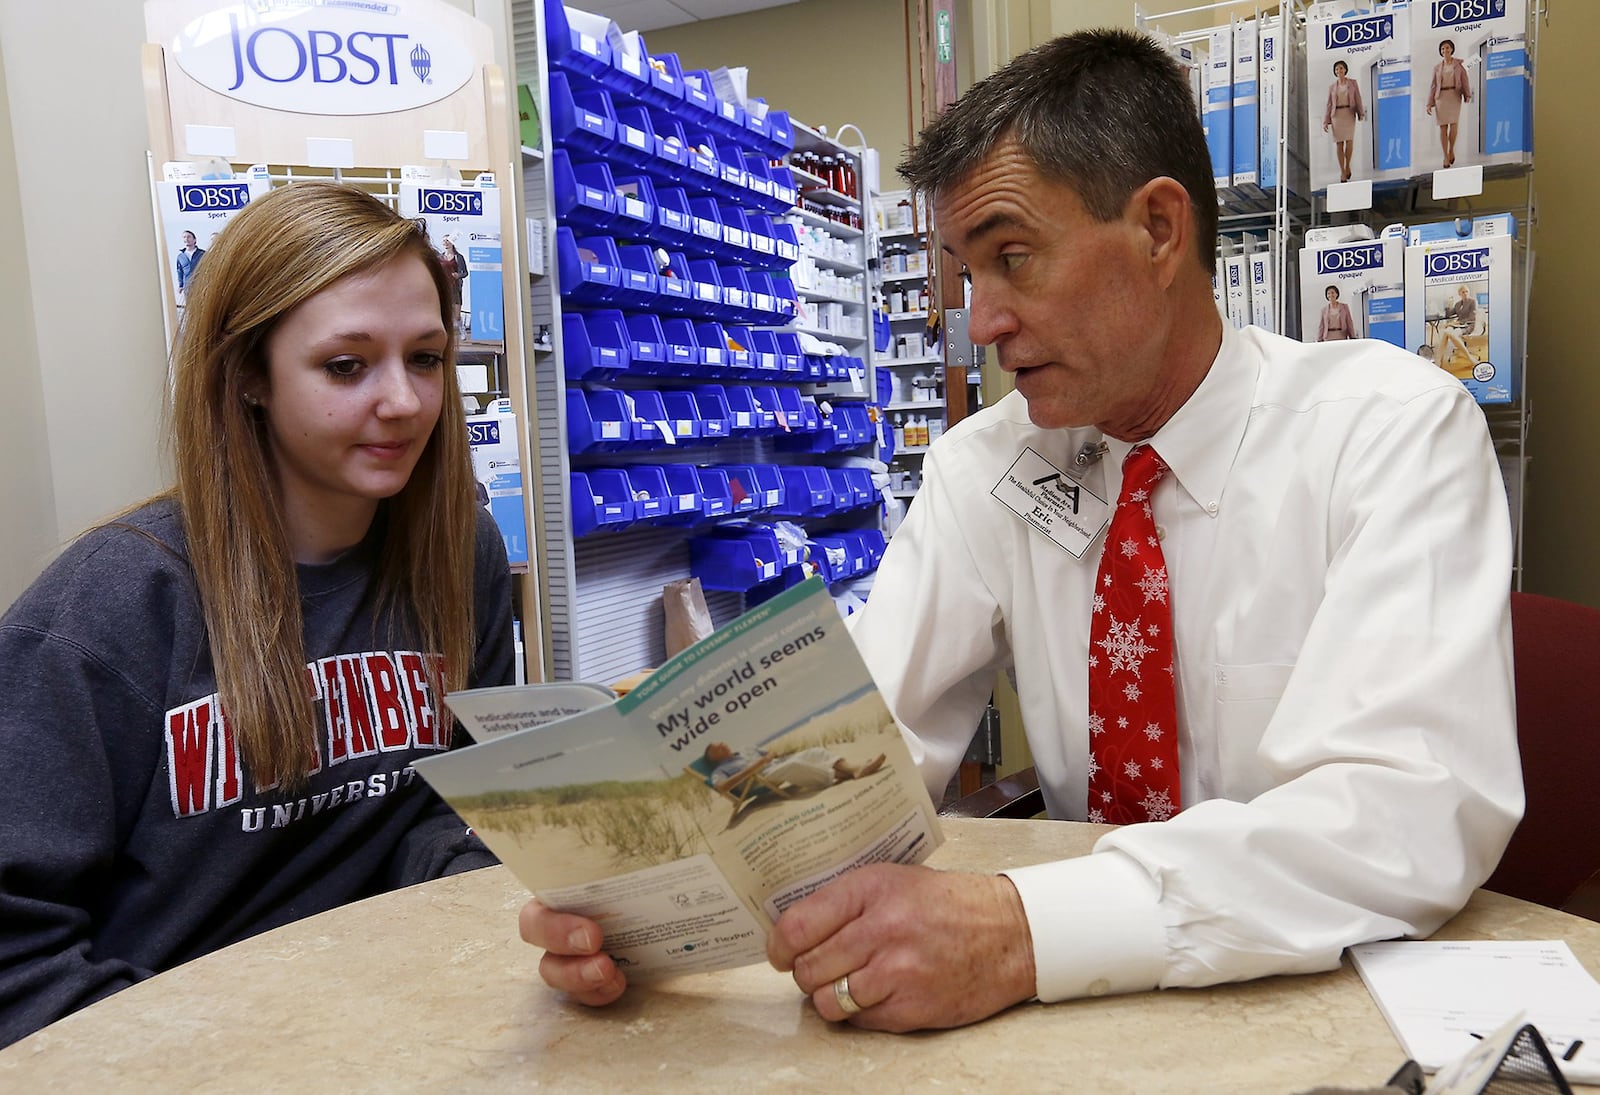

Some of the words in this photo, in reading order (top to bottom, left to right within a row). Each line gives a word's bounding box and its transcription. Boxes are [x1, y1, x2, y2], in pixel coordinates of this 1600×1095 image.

[1432, 0, 1491, 27] JOBST
[1327, 19, 1385, 48] JOBST
[1454, 23, 1482, 32] Opaque
[228, 13, 409, 90] JOBST
[1347, 45, 1372, 54] Opaque
[179, 185, 240, 211] JOBST
[419, 188, 475, 212] JOBST
[1318, 247, 1375, 274] JOBST
[1425, 251, 1481, 276] JOBST
[1338, 271, 1363, 280] Opaque
[1430, 275, 1455, 284] Medical
[467, 424, 492, 442] BST
[1008, 475, 1016, 484] The
[1040, 491, 1064, 511] Pharmacy
[1024, 512, 1051, 533] Pharmacist
[1031, 506, 1053, 525] Eric
[636, 679, 660, 700] YOUR
[658, 662, 683, 682] GUIDE
[683, 652, 696, 664] TO
[679, 684, 695, 700] my
[694, 655, 739, 687] diabetes
[748, 631, 779, 653] under
[655, 707, 690, 739] My
[694, 661, 756, 709] world
[760, 626, 826, 669] seems
[474, 709, 535, 723] Indications
[538, 707, 560, 716] and
[669, 713, 721, 752] wide
[725, 677, 779, 714] open
[165, 650, 452, 820] WIENBE
[241, 766, 417, 832] UNIVERSIT
[739, 823, 782, 854] INDICATIONS
[783, 814, 800, 825] AND
[800, 803, 825, 816] USAGE
[772, 892, 792, 904] Please
